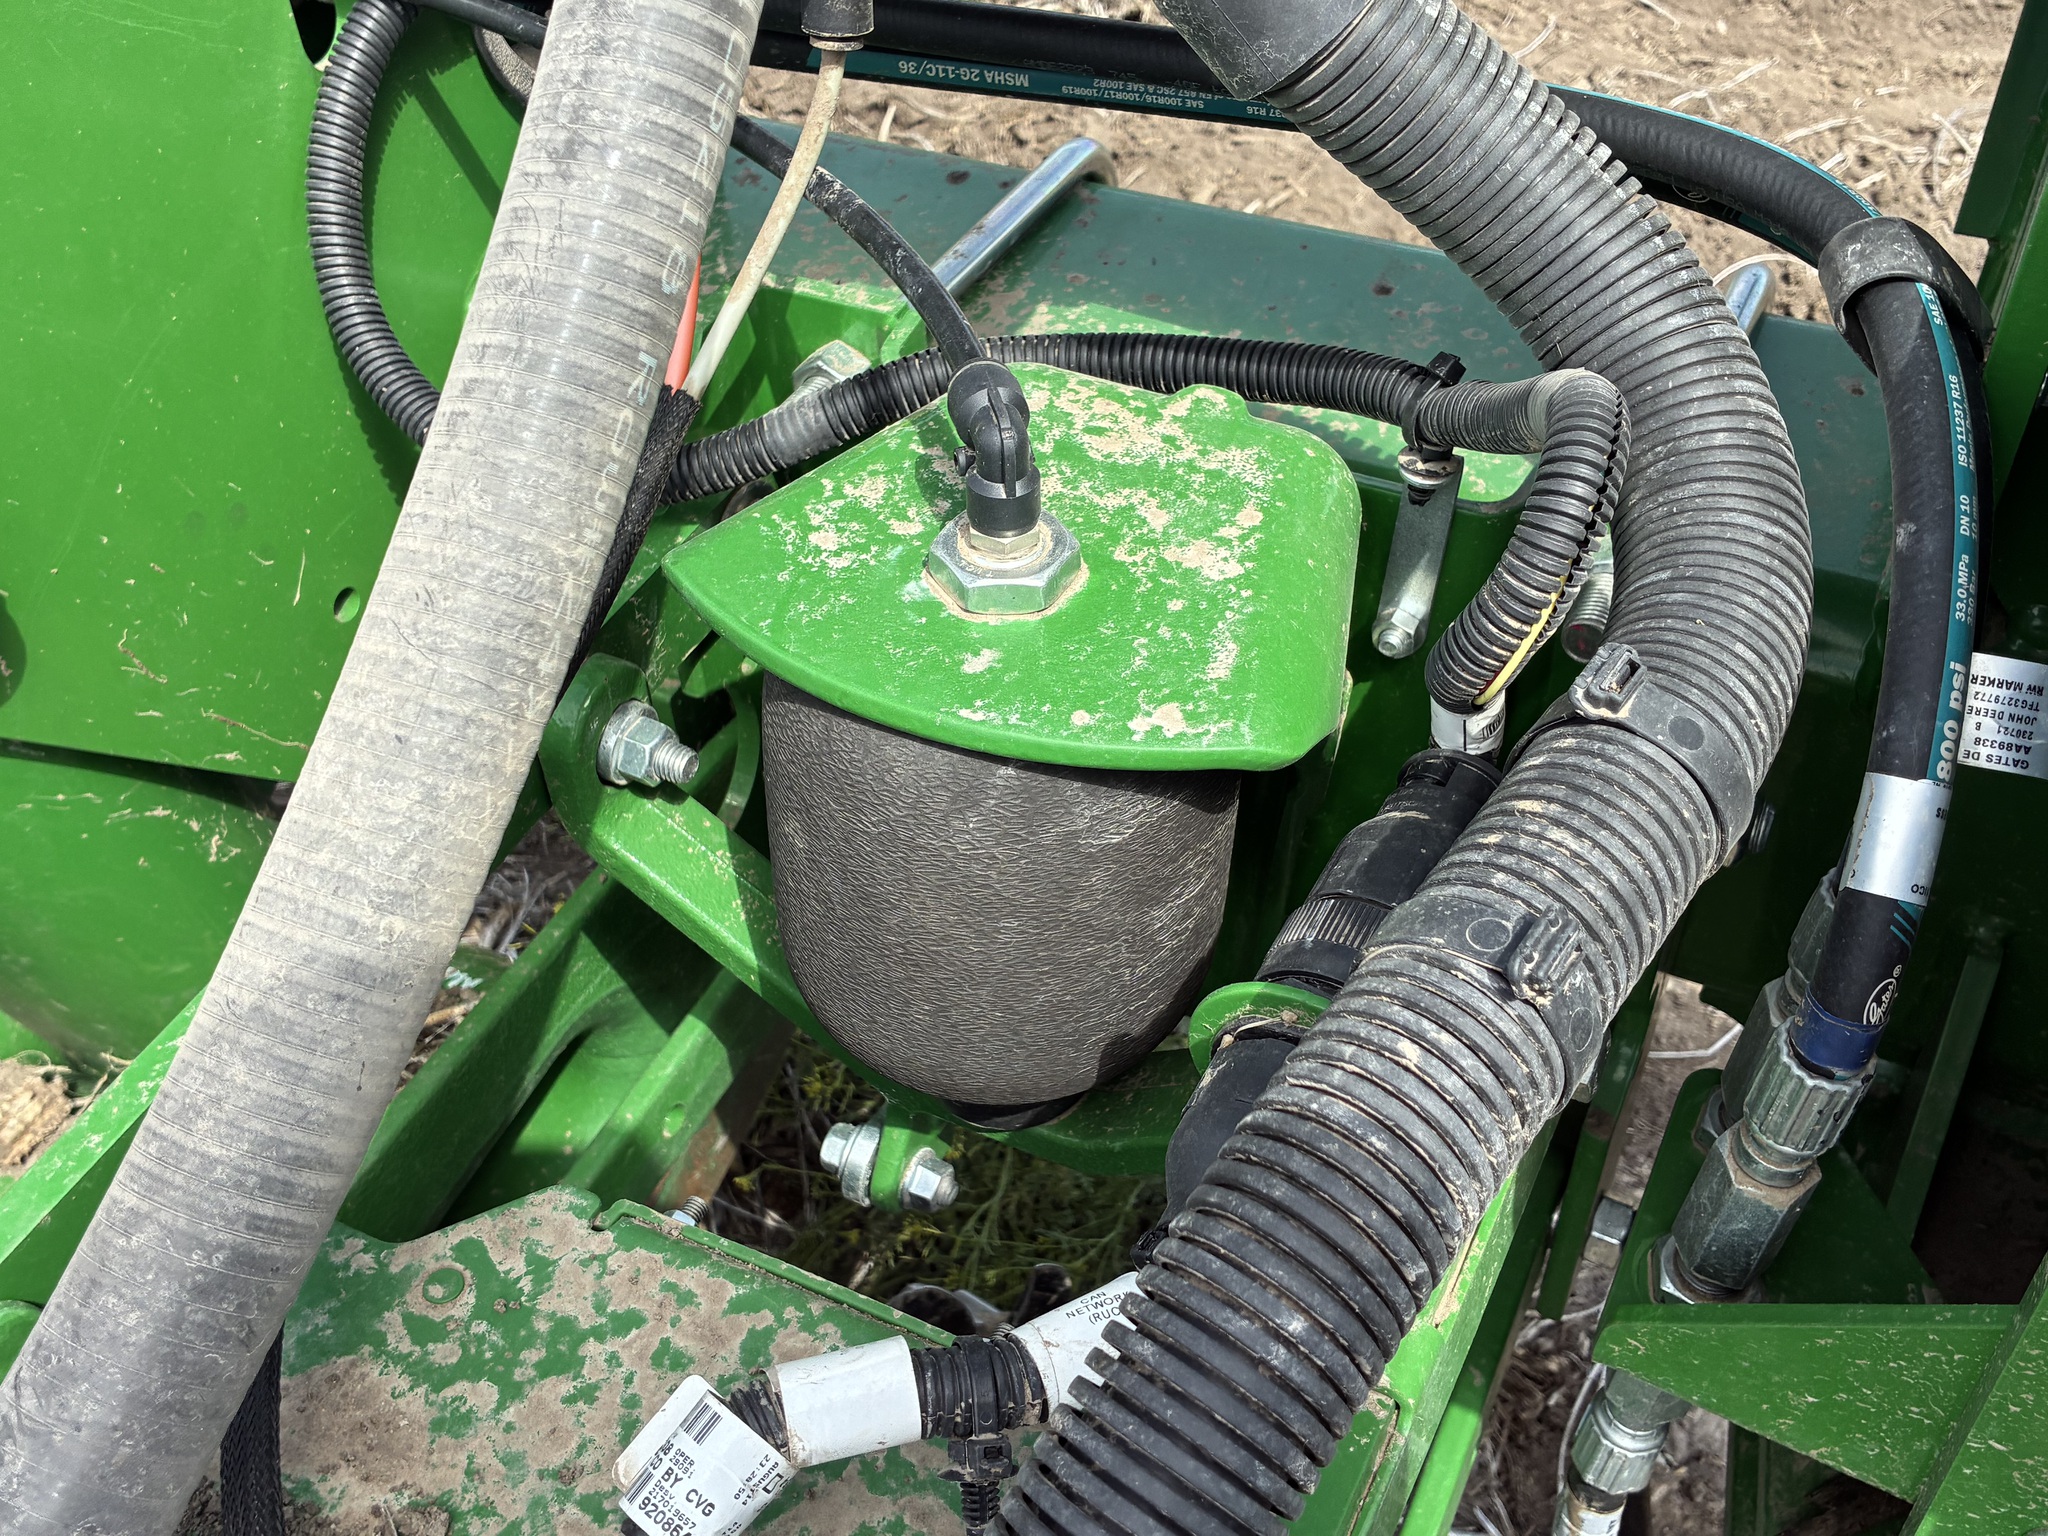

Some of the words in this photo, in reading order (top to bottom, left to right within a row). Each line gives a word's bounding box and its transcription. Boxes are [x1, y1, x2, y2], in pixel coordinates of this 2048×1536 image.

[899, 60, 980, 82] 2G-11C/36
[984, 70, 1029, 87] MSHA
[1093, 78, 1125, 89] 100R2
[1126, 82, 1145, 92] SAE
[1156, 86, 1177, 95] 2SC
[1062, 85, 1182, 106] 100R16/100R17/100R19
[1185, 99, 1204, 109] SAE
[1246, 106, 1267, 116] R16
[1929, 302, 1943, 326] SAE
[1949, 374, 1961, 400] R16
[1952, 401, 1966, 443] 11237
[1957, 445, 1968, 468] ISO
[1960, 495, 1970, 513] 10
[1960, 515, 1970, 536] DN
[1949, 661, 1967, 712] psi
[1970, 674, 2024, 692] MARKER
[1974, 691, 2040, 712] TFG3279772
[1966, 705, 2004, 720] DEERE
[2008, 712, 2037, 726] JOHN
[1975, 722, 1982, 731] B
[1997, 725, 2034, 740] 230721
[1962, 749, 1980, 761] DE
[1974, 737, 2032, 755] AA89338
[1985, 753, 2030, 769] GATES
[1080, 1291, 1107, 1304] CAN
[669, 1455, 694, 1479] 29091
[733, 1454, 771, 1500] 23:28:50
[661, 1467, 683, 1489] BY
[685, 1489, 716, 1517] CVG
[648, 1488, 697, 1530] 217019657
